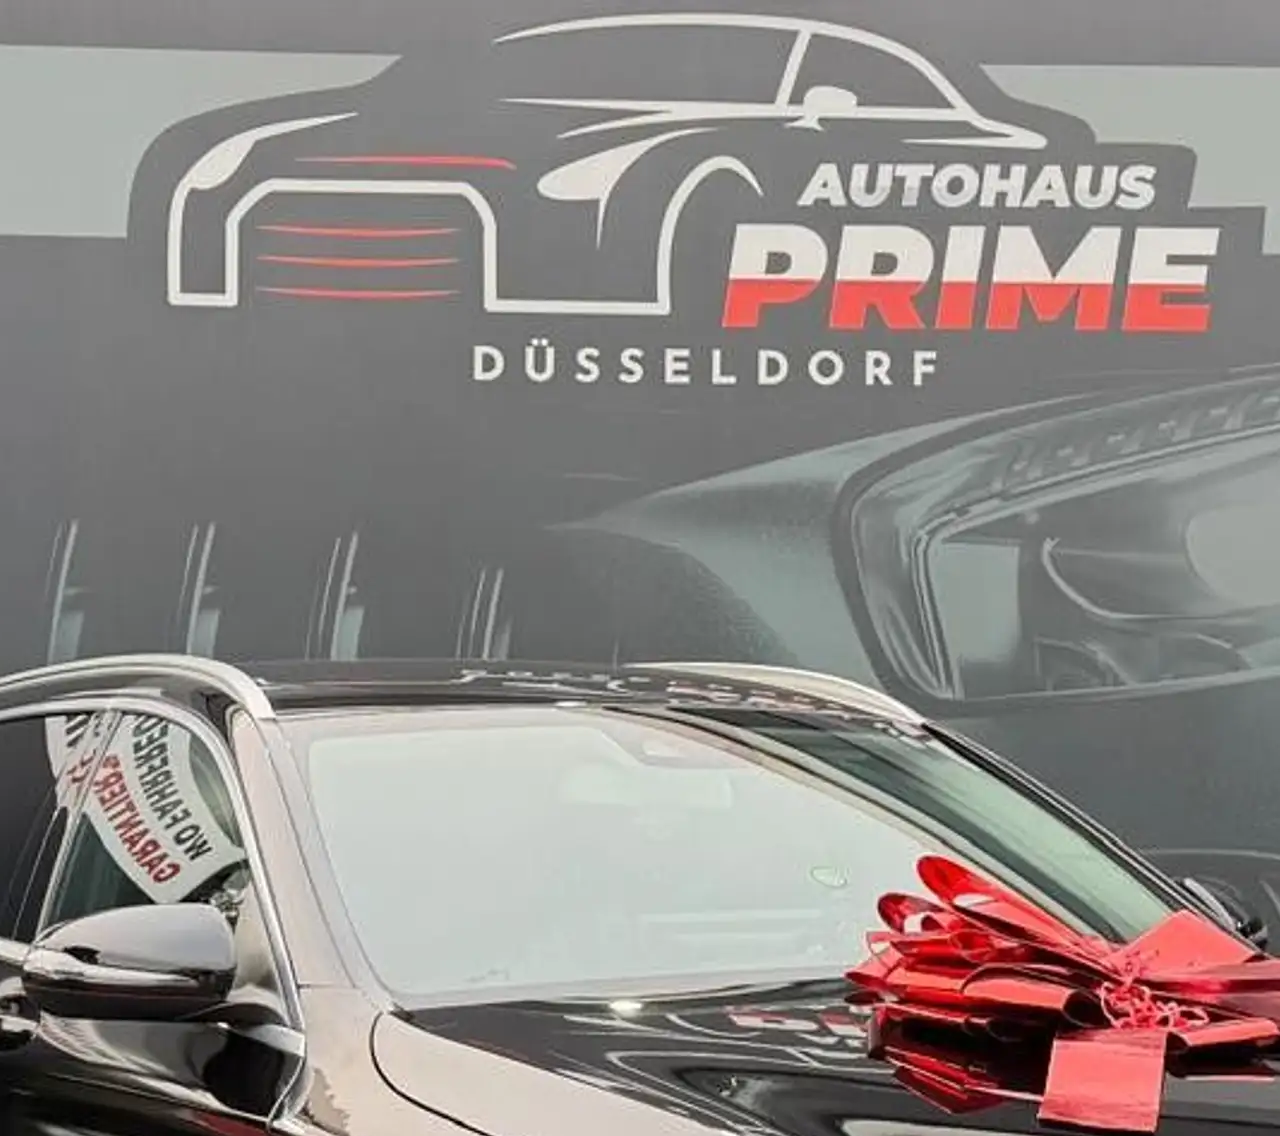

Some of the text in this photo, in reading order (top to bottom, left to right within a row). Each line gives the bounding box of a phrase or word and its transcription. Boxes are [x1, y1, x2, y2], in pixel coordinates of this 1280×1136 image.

[796, 162, 1158, 210] AUTOHAUS
[721, 223, 1221, 332] PRIME
[472, 336, 938, 388] DÜSSELDORF
